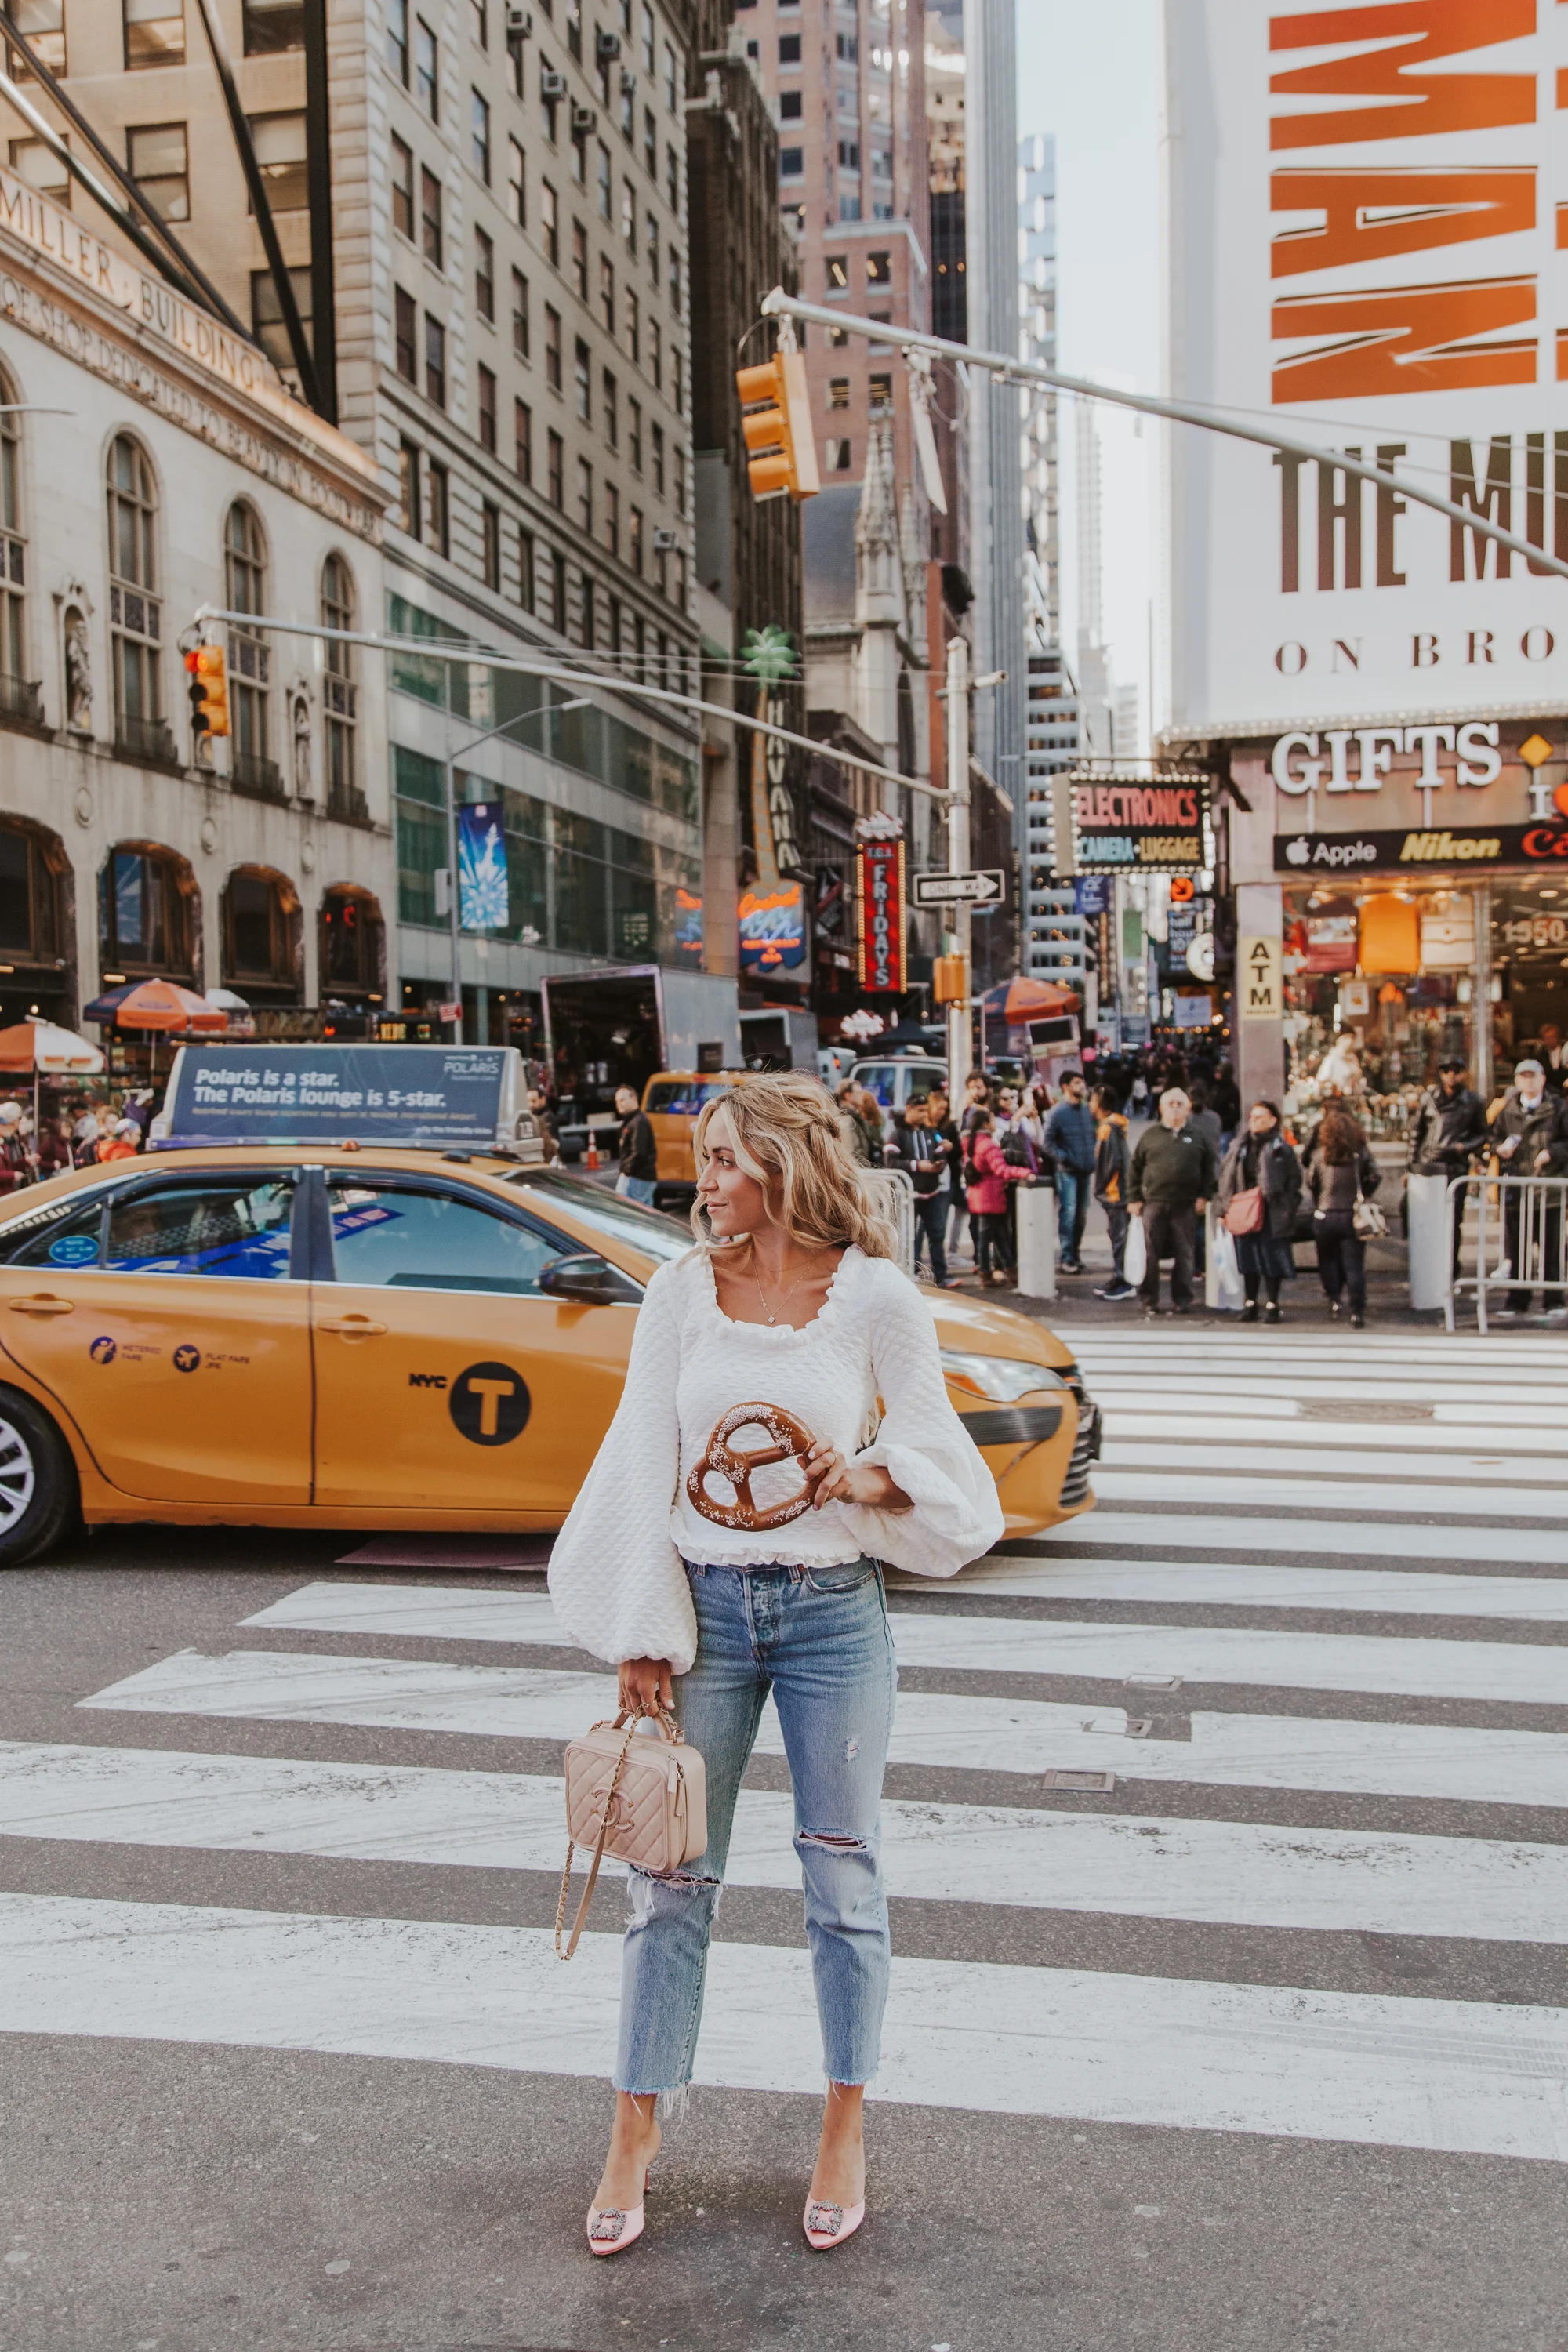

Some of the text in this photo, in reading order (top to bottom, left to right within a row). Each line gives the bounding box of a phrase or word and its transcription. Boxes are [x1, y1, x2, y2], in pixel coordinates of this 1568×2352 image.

[0, 176, 254, 390] MILLER BUILDING
[42, 298, 93, 367] SHOP
[1272, 444, 1406, 593] THE
[1274, 624, 1555, 677] ON BRO
[766, 699, 802, 871] HAVANA
[1271, 722, 1503, 795] GIFTS
[1075, 786, 1199, 827] ELECTRONICS
[1079, 836, 1200, 862] CAMERA LUGGAGE
[1313, 840, 1377, 867] Apple
[1399, 832, 1501, 862] Nikon
[929, 883, 987, 894] ONE WAY
[873, 863, 891, 987] FRIDAYS
[1250, 942, 1271, 1005] ATM
[196, 1069, 339, 1088] Polaris is a star.
[443, 1062, 499, 1074] POLARIS
[193, 1086, 447, 1109] The Polaris lounge is 5-star.
[408, 1373, 515, 1436] NYC T
